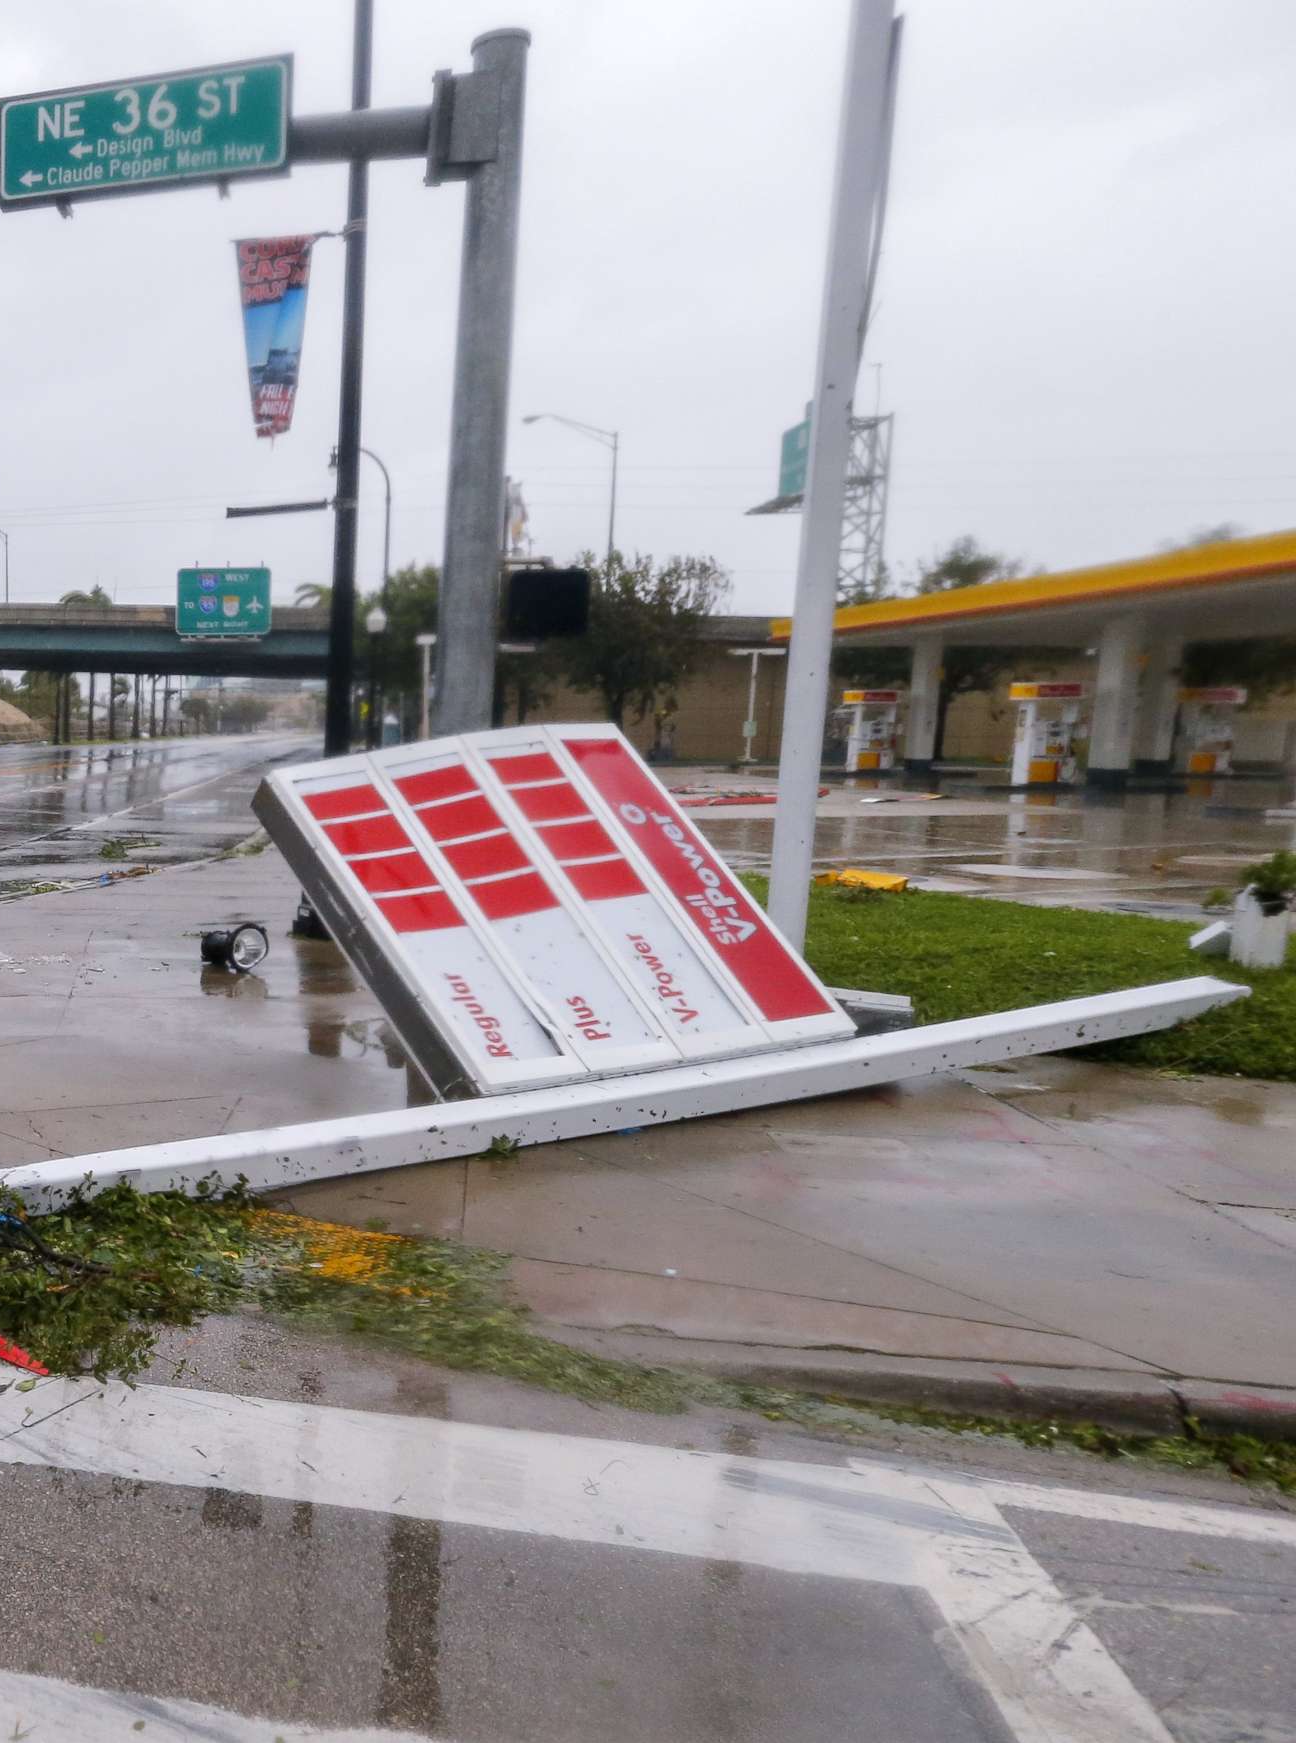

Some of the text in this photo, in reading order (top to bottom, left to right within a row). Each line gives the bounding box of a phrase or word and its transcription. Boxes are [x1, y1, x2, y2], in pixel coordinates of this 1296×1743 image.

[37, 76, 245, 142] NE 36 ST
[47, 161, 103, 186] Claude
[109, 154, 168, 179] Pepper
[224, 142, 265, 164] Hwy
[97, 125, 202, 157] Design Blvd
[225, 573, 250, 583] WEST
[184, 601, 194, 609] TO
[651, 811, 757, 942] V-Power
[686, 894, 737, 945] Shell
[626, 934, 699, 1024] V-Power
[447, 975, 513, 1057] Regular
[567, 996, 611, 1040] Plus
